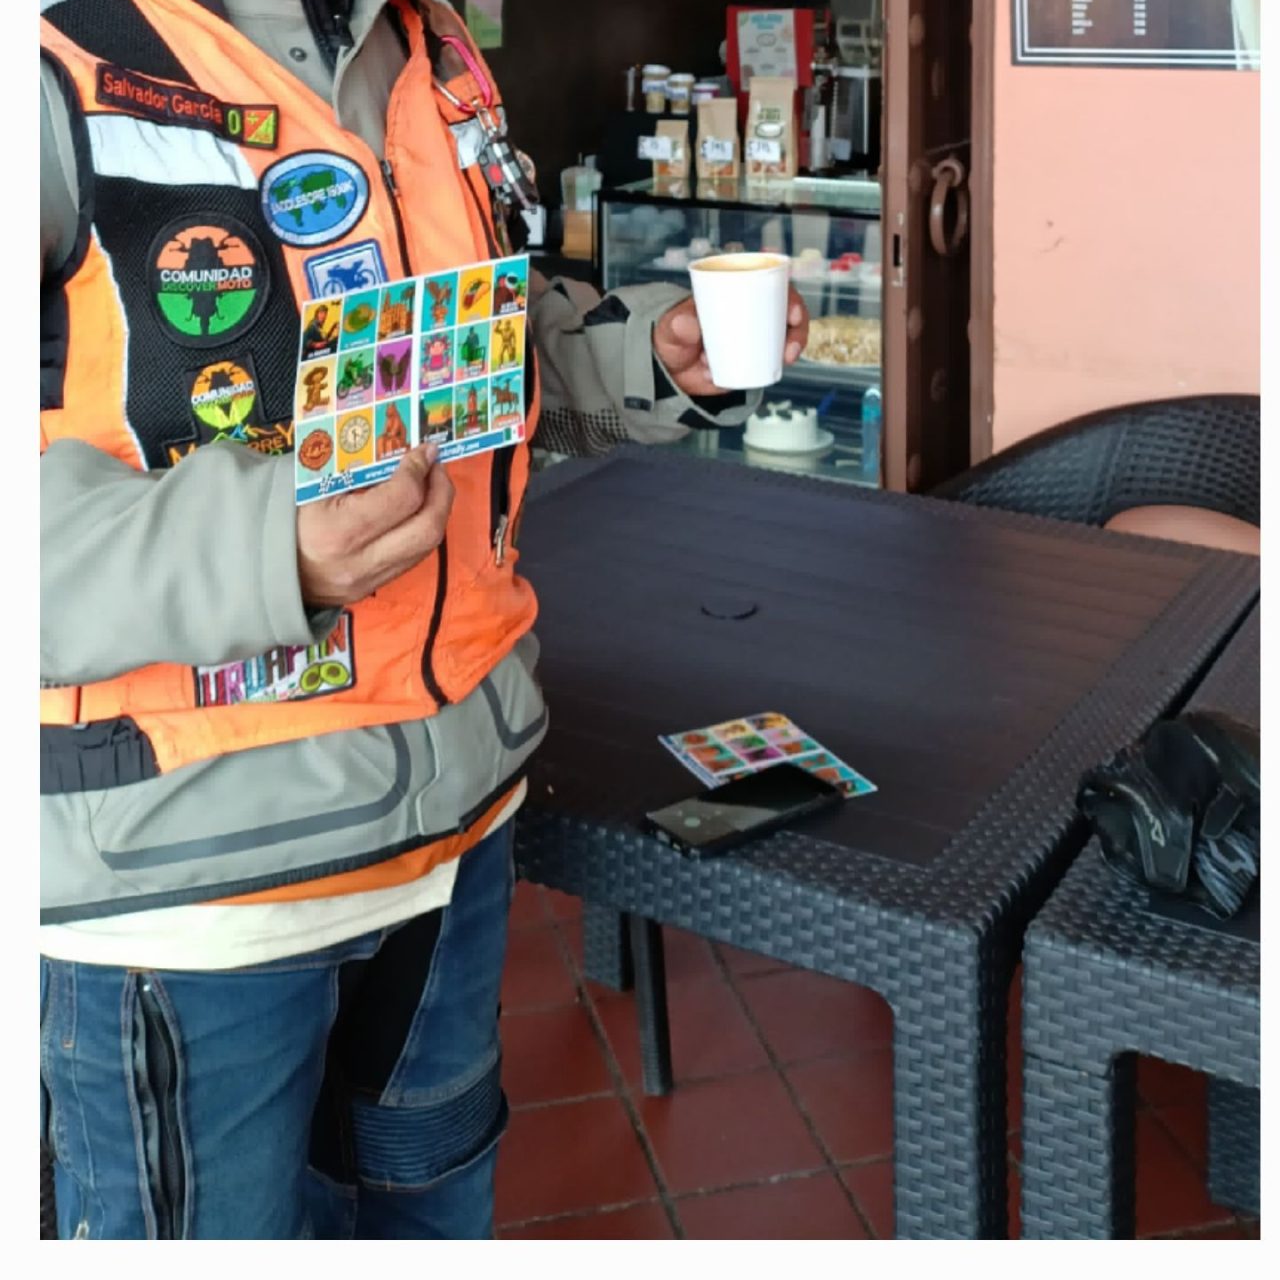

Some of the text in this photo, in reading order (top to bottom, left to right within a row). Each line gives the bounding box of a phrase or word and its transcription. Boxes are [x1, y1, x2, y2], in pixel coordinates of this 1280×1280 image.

[103, 72, 168, 111] Salvador
[172, 93, 223, 124] García
[160, 266, 252, 283] COMUNIDAD
